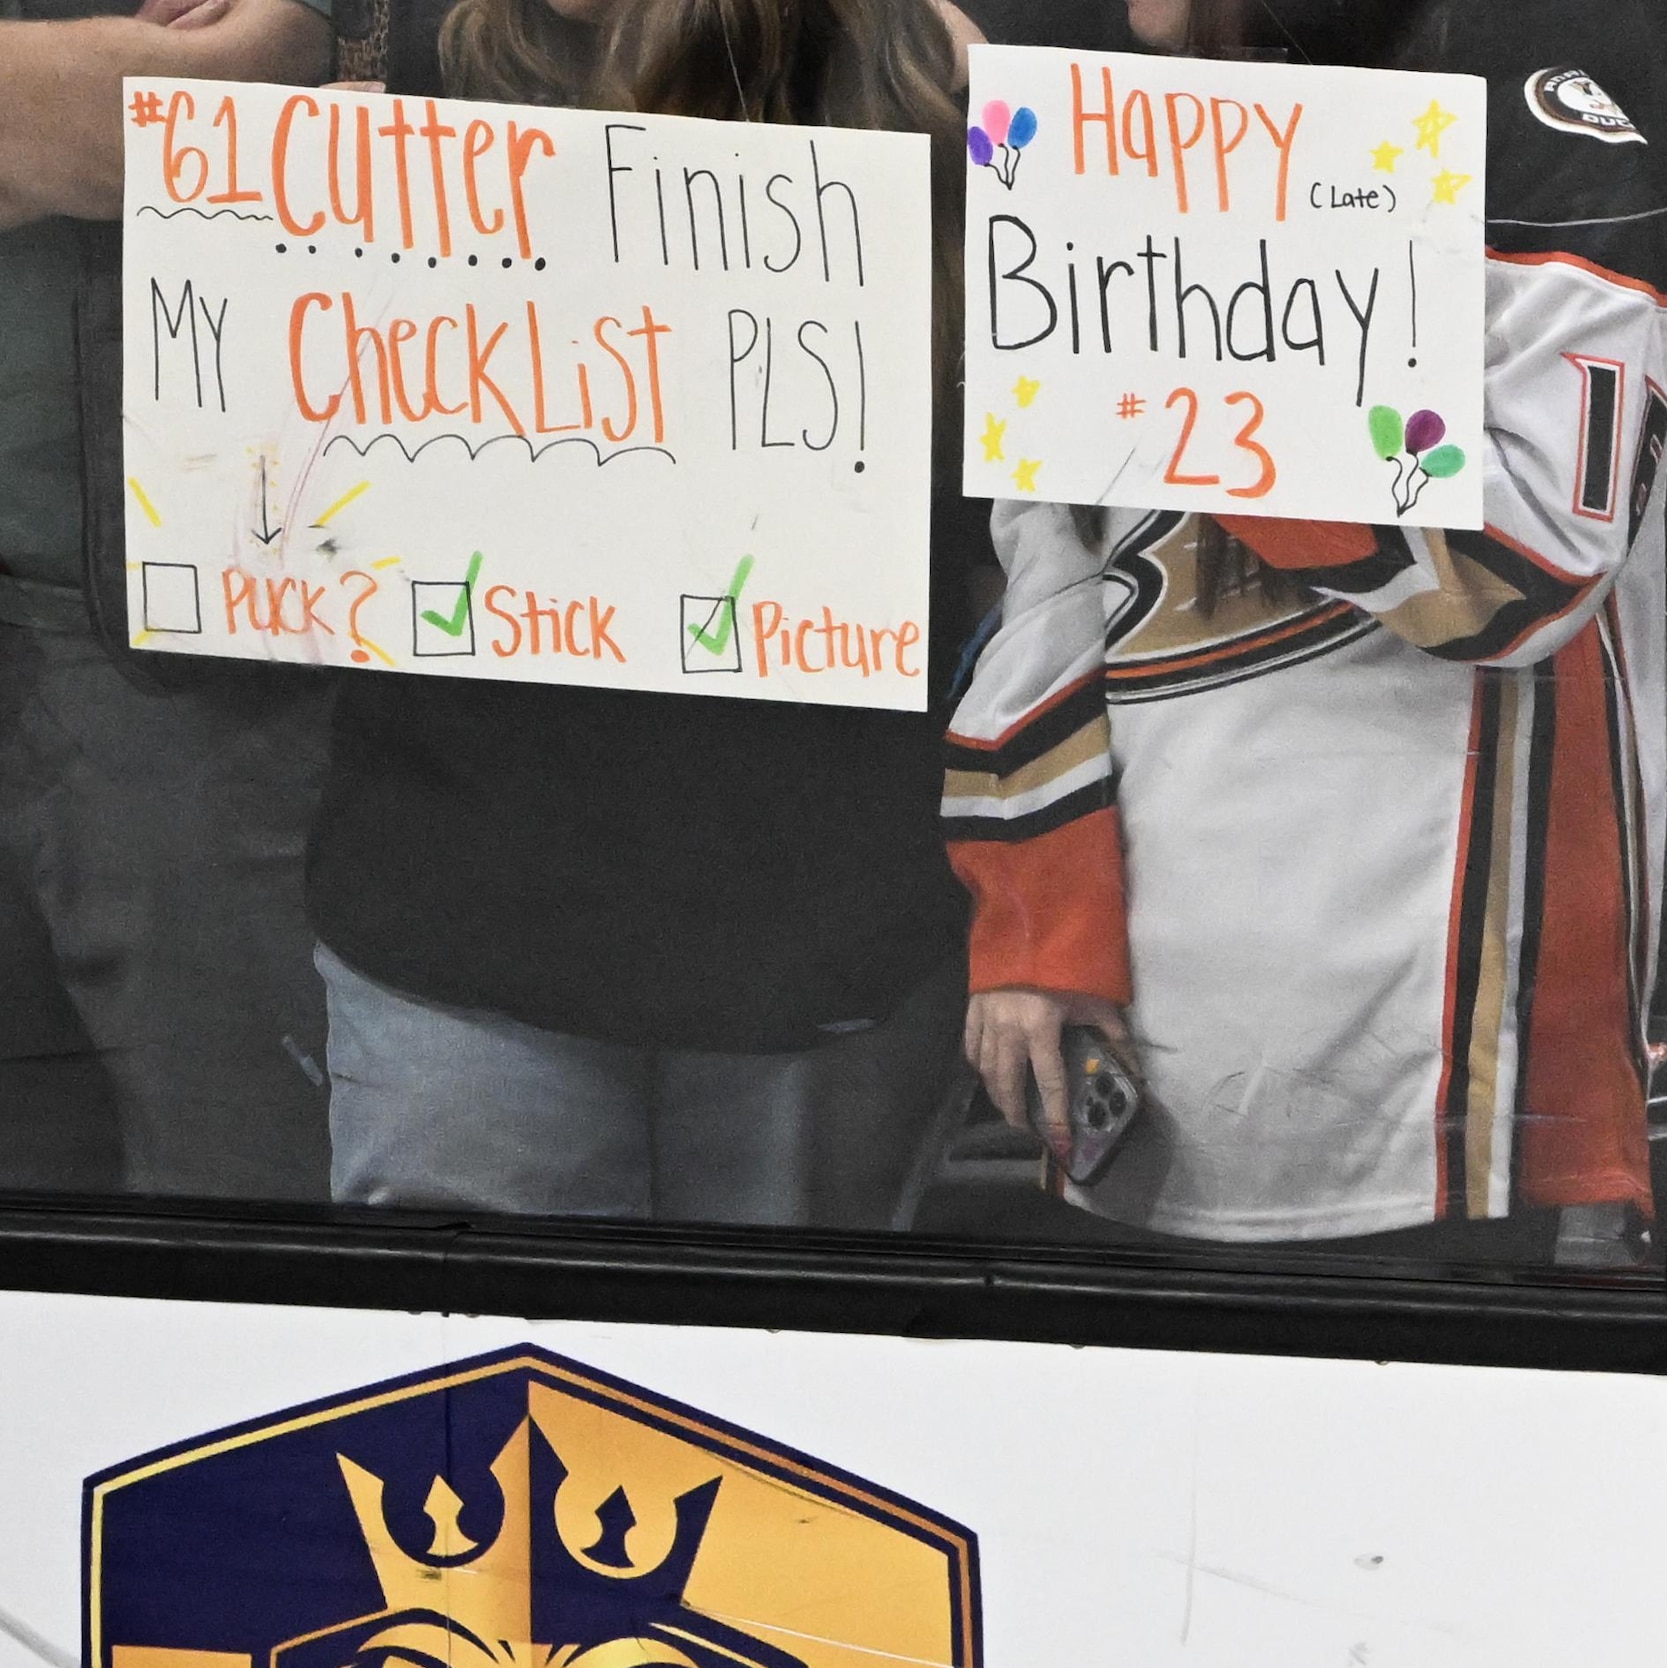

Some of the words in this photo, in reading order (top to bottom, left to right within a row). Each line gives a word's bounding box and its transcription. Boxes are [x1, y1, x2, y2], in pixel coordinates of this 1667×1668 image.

[129, 90, 262, 204] #61
[605, 125, 864, 286] Finish
[1309, 183, 1397, 213] (Late)
[988, 213, 1419, 407] Birthday!
[729, 308, 867, 474] PLS!
[1115, 387, 1279, 499] #23
[484, 584, 627, 664] Stick
[751, 601, 922, 679] Picture
